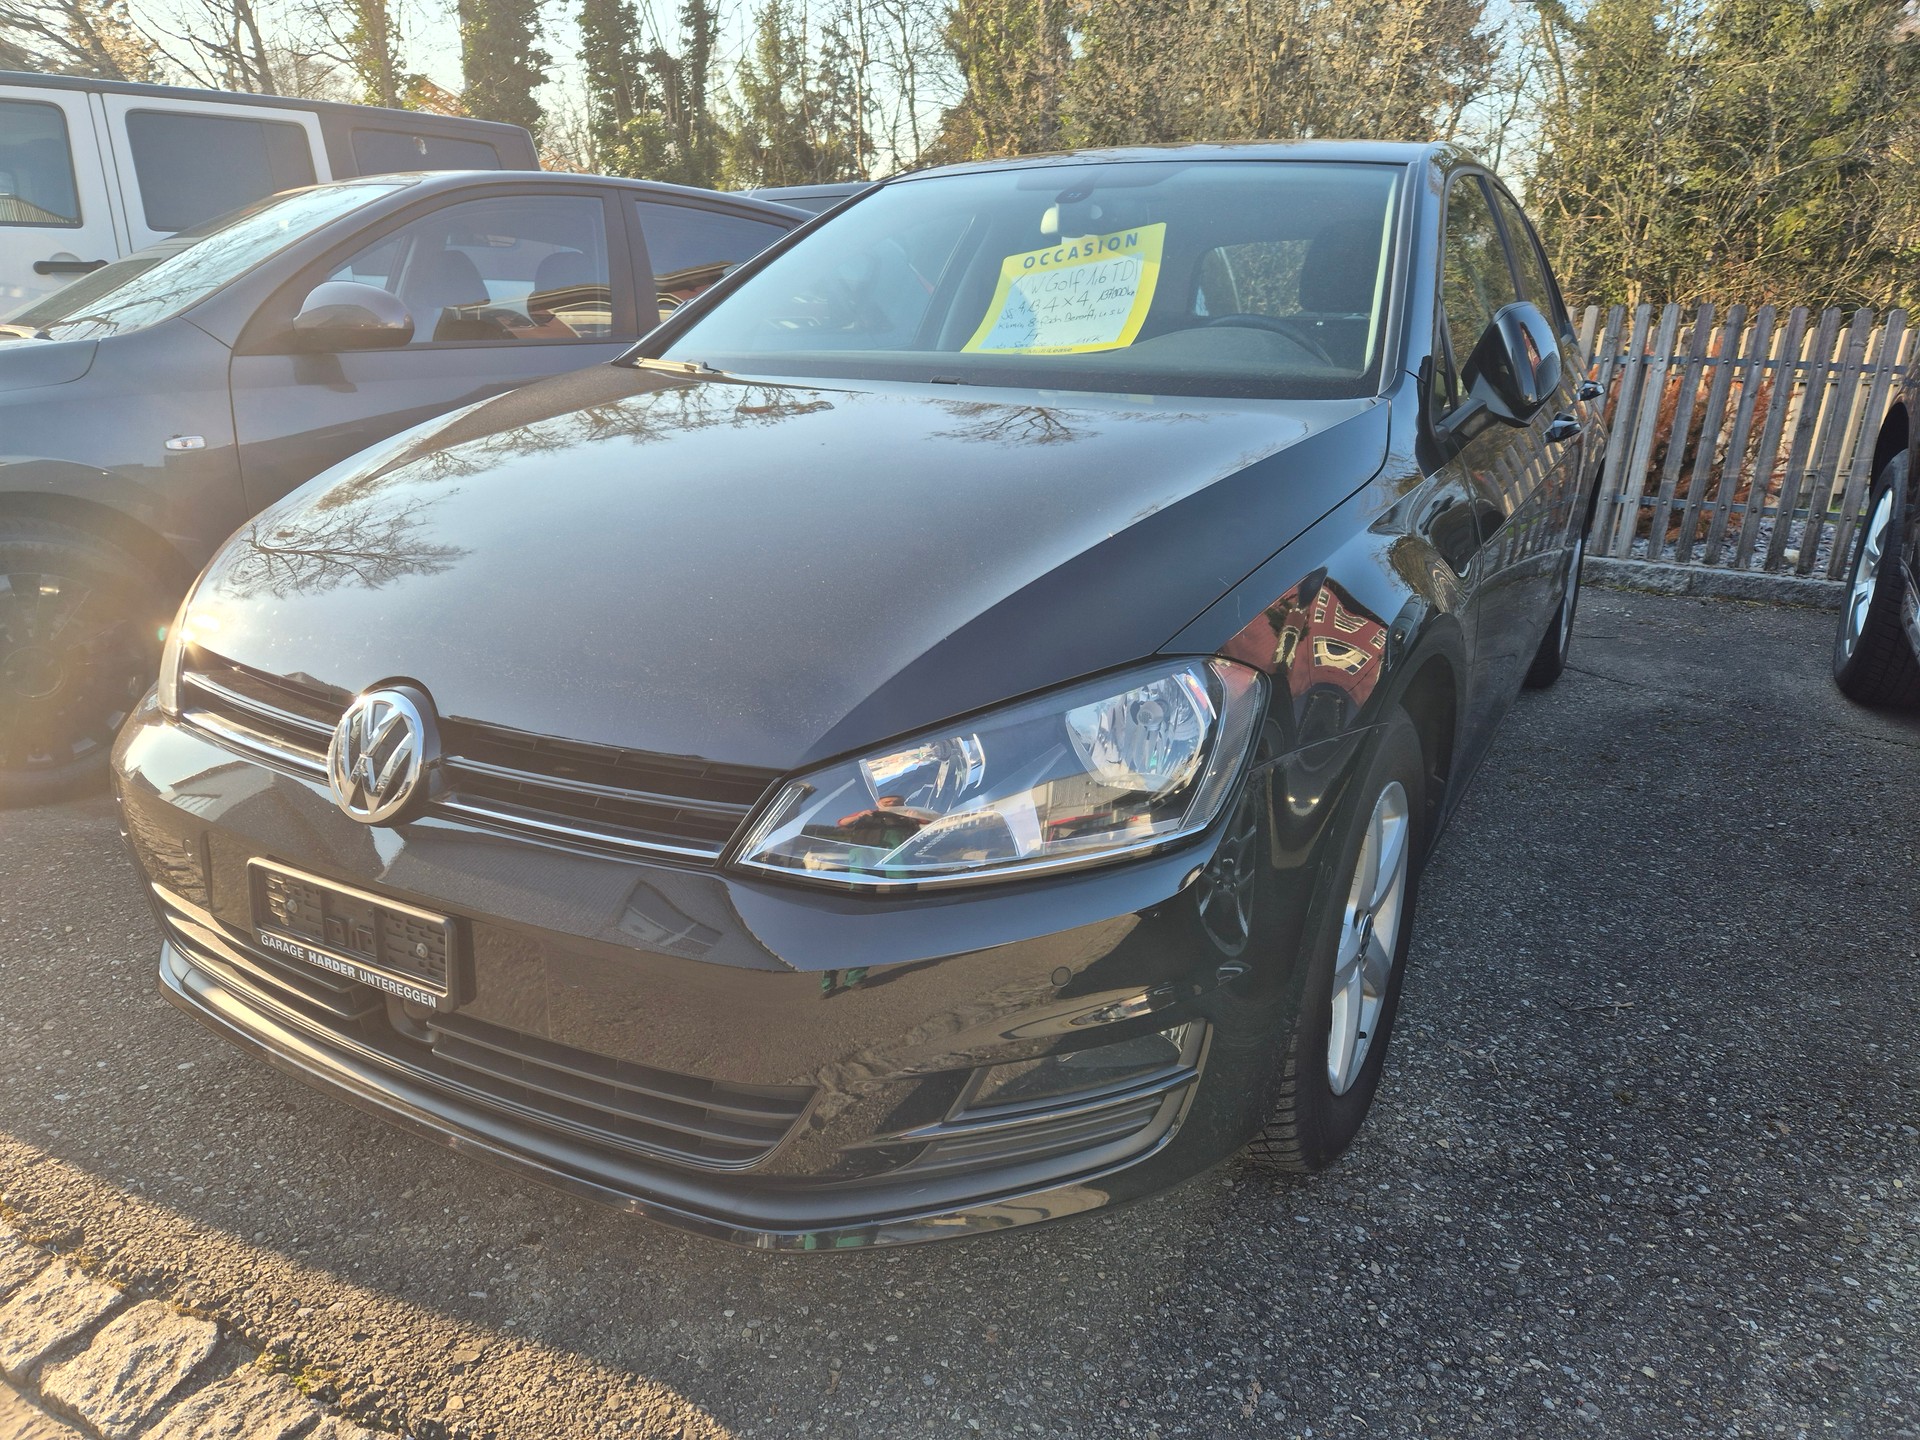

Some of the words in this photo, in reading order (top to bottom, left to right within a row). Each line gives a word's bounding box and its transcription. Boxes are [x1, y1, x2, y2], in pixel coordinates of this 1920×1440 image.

[1023, 232, 1139, 269] OCCASION
[1045, 268, 1085, 293] Golf
[1112, 257, 1139, 283] TDI
[333, 695, 418, 818] VW
[261, 934, 304, 959] GARAGE
[308, 952, 356, 977] HARDER
[359, 970, 437, 1009] UNTEREGGEN
